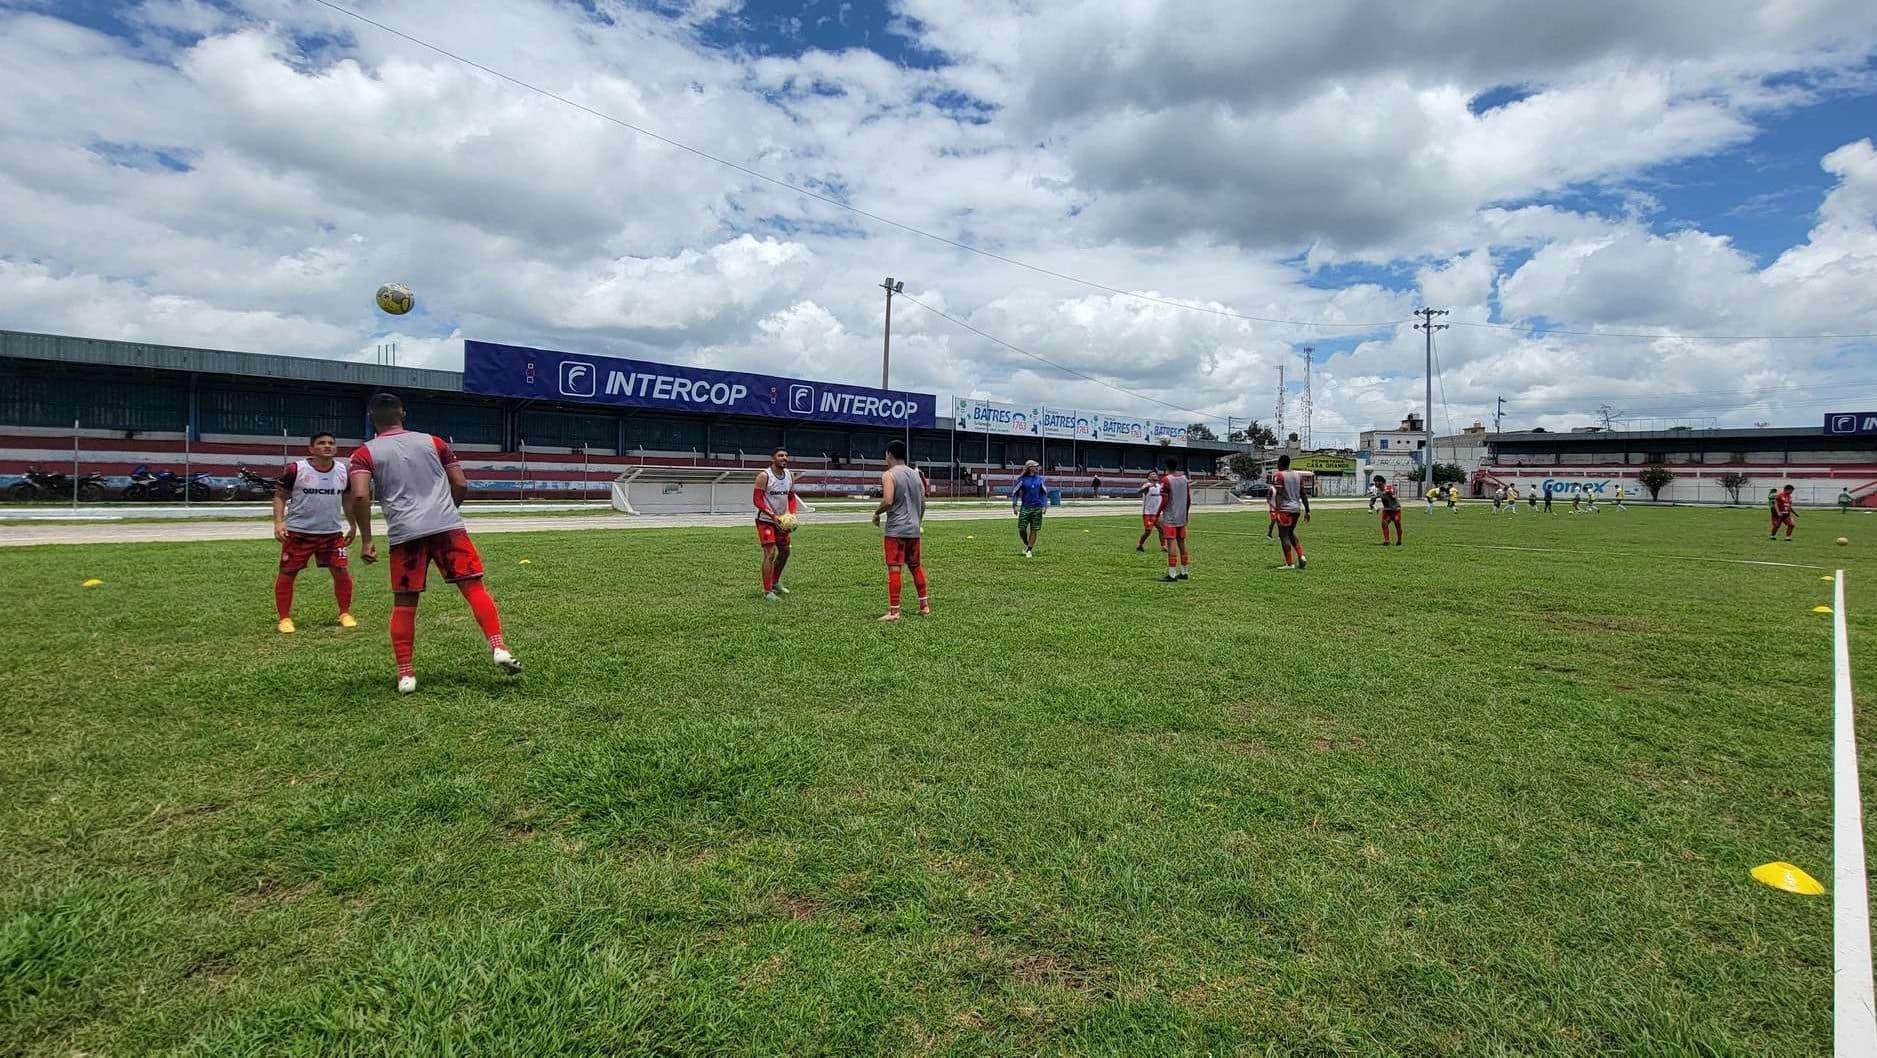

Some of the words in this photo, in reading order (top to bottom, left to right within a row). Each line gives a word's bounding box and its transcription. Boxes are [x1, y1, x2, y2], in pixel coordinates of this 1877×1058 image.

[605, 370, 748, 407] INTERCOP
[820, 391, 919, 420] INTERCOP
[973, 407, 1011, 423] BATRES
[1044, 414, 1076, 429] BATRES
[1103, 421, 1131, 434] BATRES
[1154, 425, 1178, 438] BATRES
